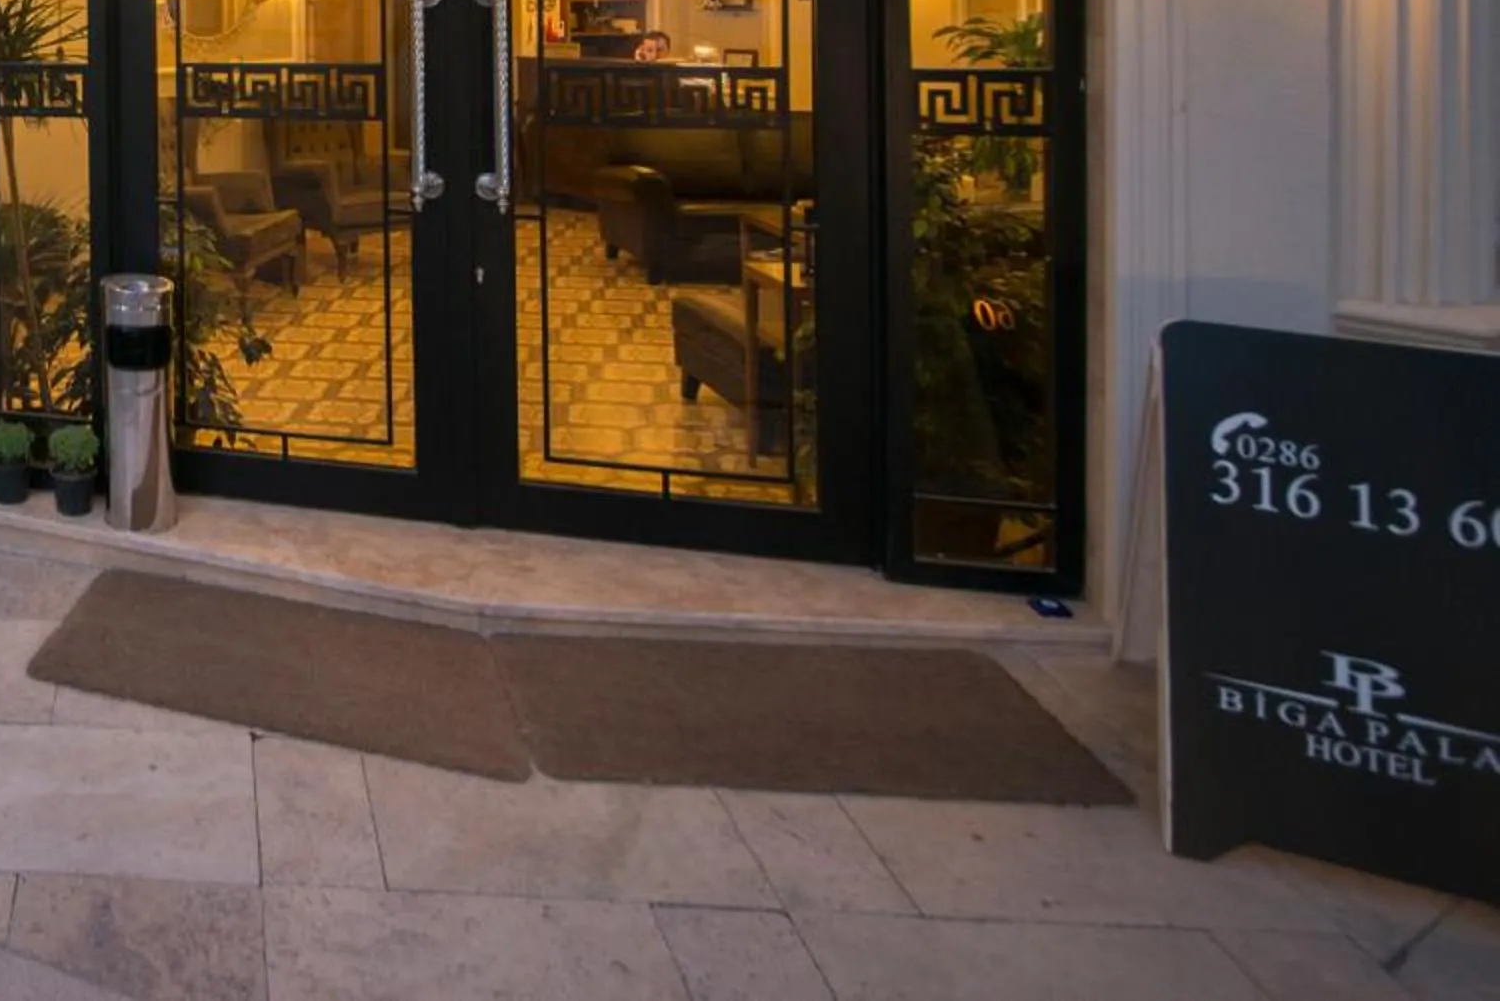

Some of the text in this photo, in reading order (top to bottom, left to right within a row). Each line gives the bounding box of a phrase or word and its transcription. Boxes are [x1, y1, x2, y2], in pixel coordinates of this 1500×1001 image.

[1236, 434, 1321, 470] 0286
[1209, 460, 1500, 548] 316 13 6
[1305, 733, 1437, 787] HOTEL
